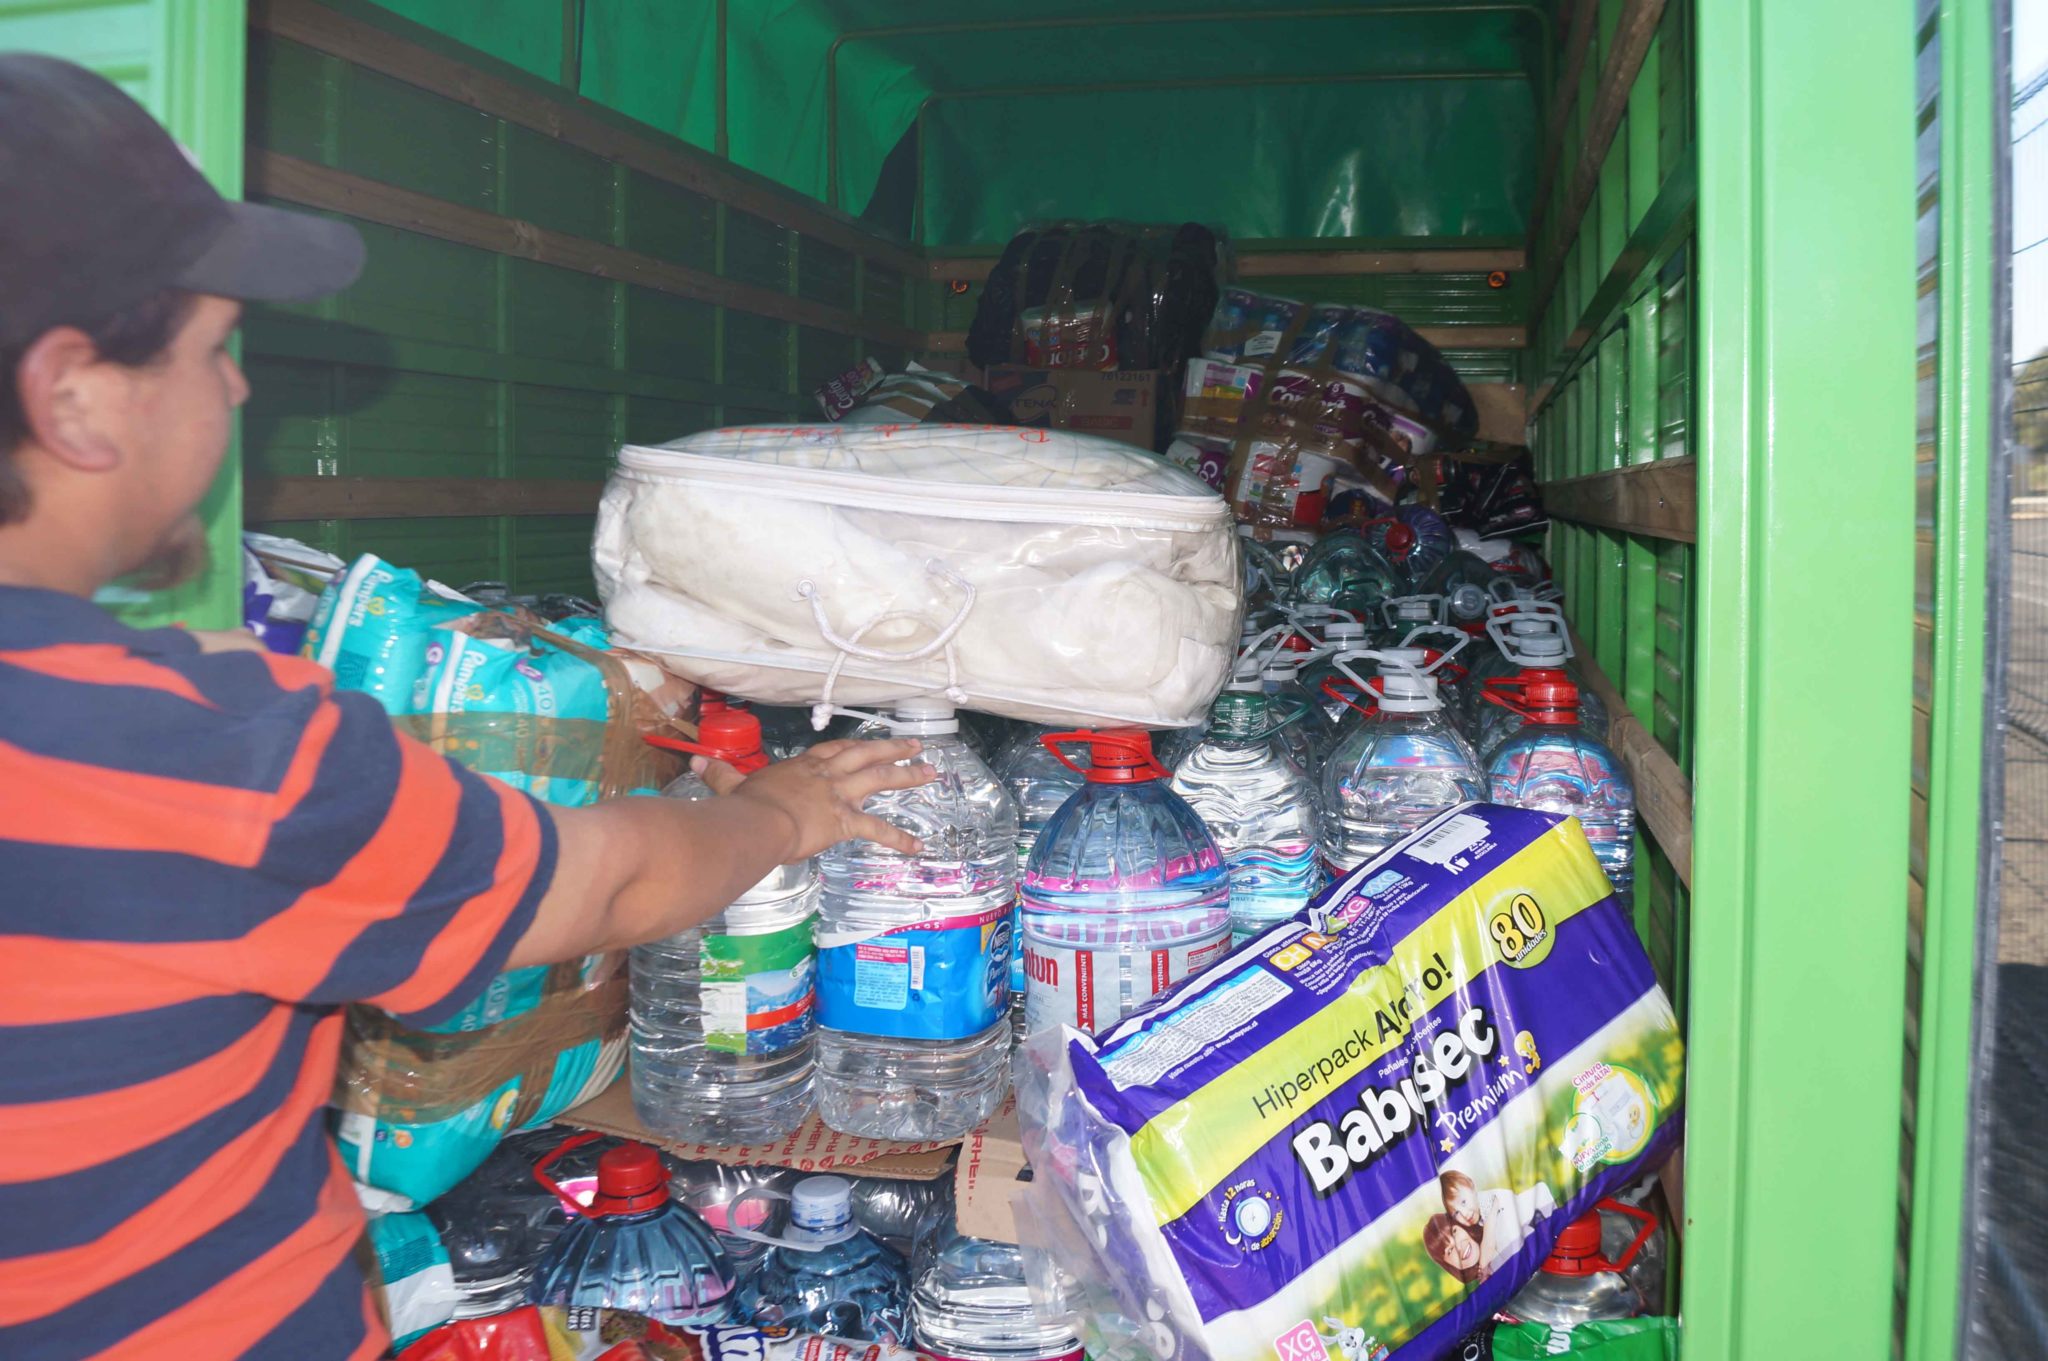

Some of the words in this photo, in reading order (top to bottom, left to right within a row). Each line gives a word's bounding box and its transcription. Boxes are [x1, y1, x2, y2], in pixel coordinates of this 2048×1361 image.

[1015, 398, 1057, 409] TENA
[347, 568, 393, 628] Pampers
[449, 648, 488, 715] Pampers
[1341, 899, 1366, 923] XG
[1490, 893, 1546, 961] 80
[1275, 946, 1308, 970] CH
[1515, 929, 1548, 963] unidades
[1080, 953, 1088, 1002] CONVENIENTE
[1156, 953, 1164, 992] NVENIENTE
[1167, 1065, 1184, 1079] Visita
[1182, 1053, 1204, 1070] nuestro
[1252, 1029, 1374, 1119] Hiperpack
[1378, 1055, 1409, 1080] Pañales
[1573, 1062, 1602, 1086] Cintura
[1594, 1065, 1611, 1083] ALTA!
[1435, 1068, 1524, 1140] Premium
[1218, 1199, 1230, 1222] Hasta
[1224, 1186, 1236, 1200] 12
[1235, 1179, 1256, 1192] horas
[1281, 1328, 1317, 1361] XG
